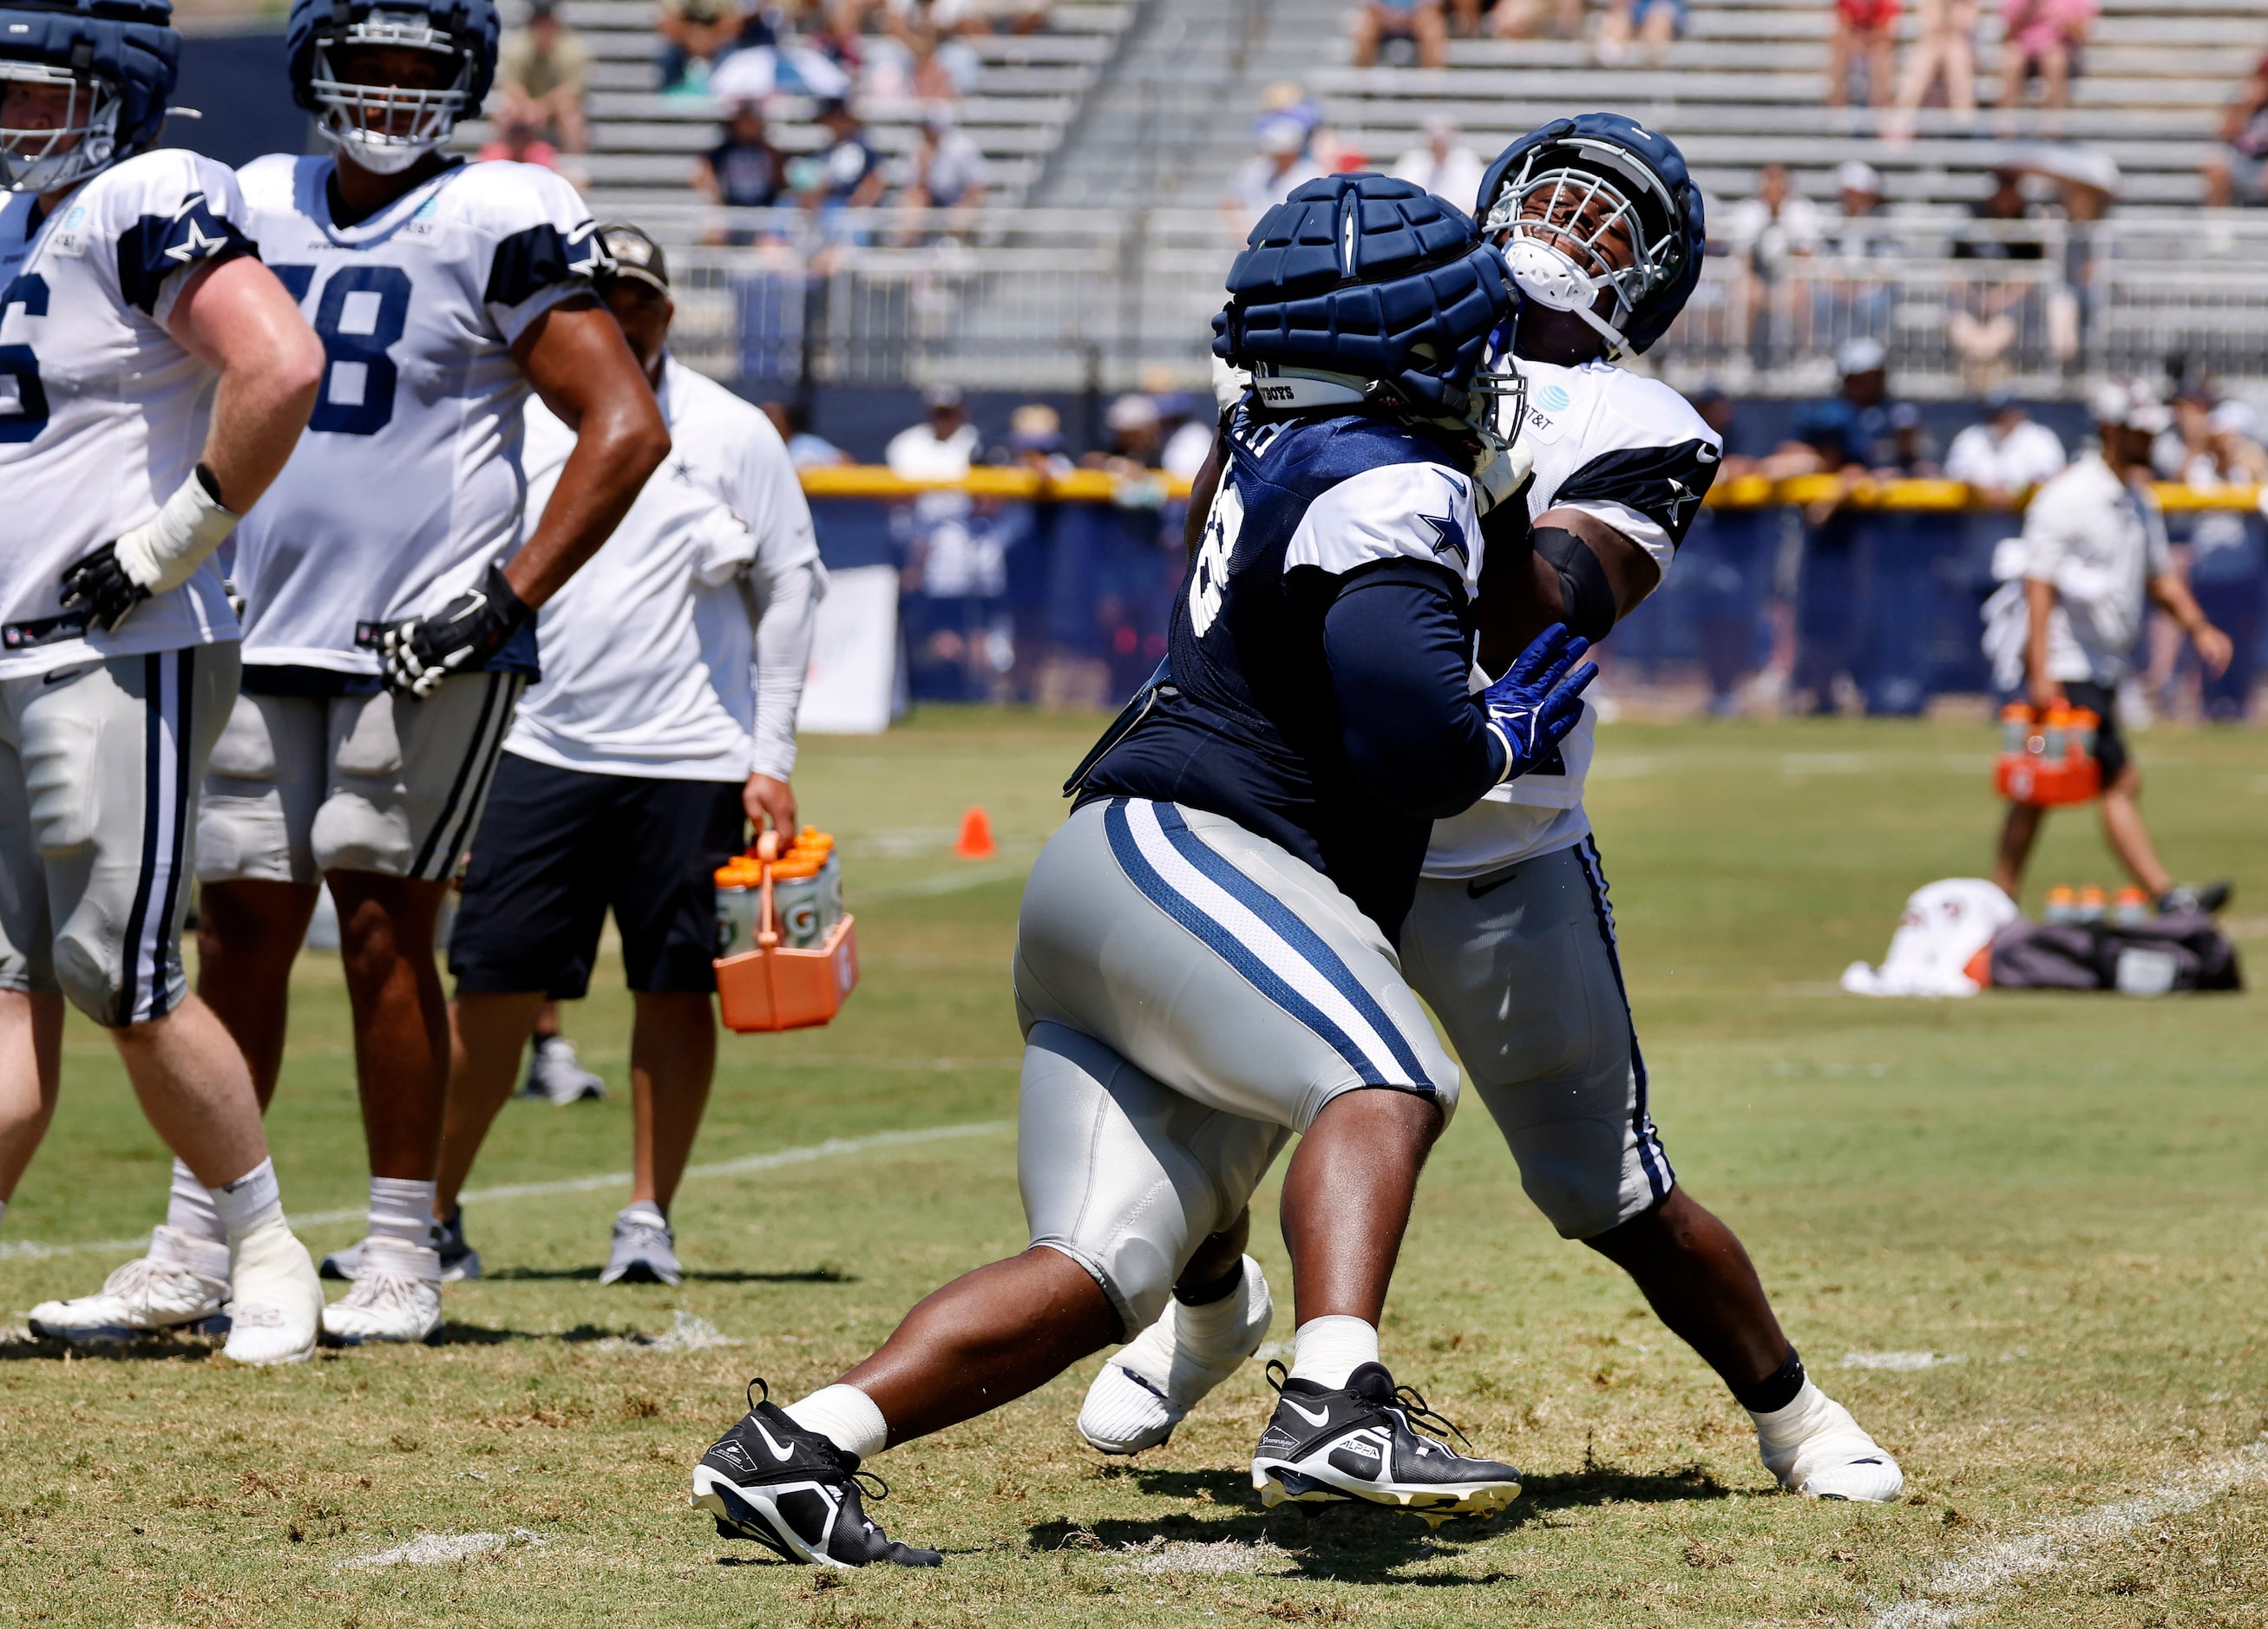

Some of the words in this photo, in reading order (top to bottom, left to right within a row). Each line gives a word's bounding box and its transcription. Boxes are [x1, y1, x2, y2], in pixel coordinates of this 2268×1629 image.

[0, 273, 50, 443] 6
[786, 903, 816, 937] G
[1340, 1440, 1378, 1457] ALPHA
